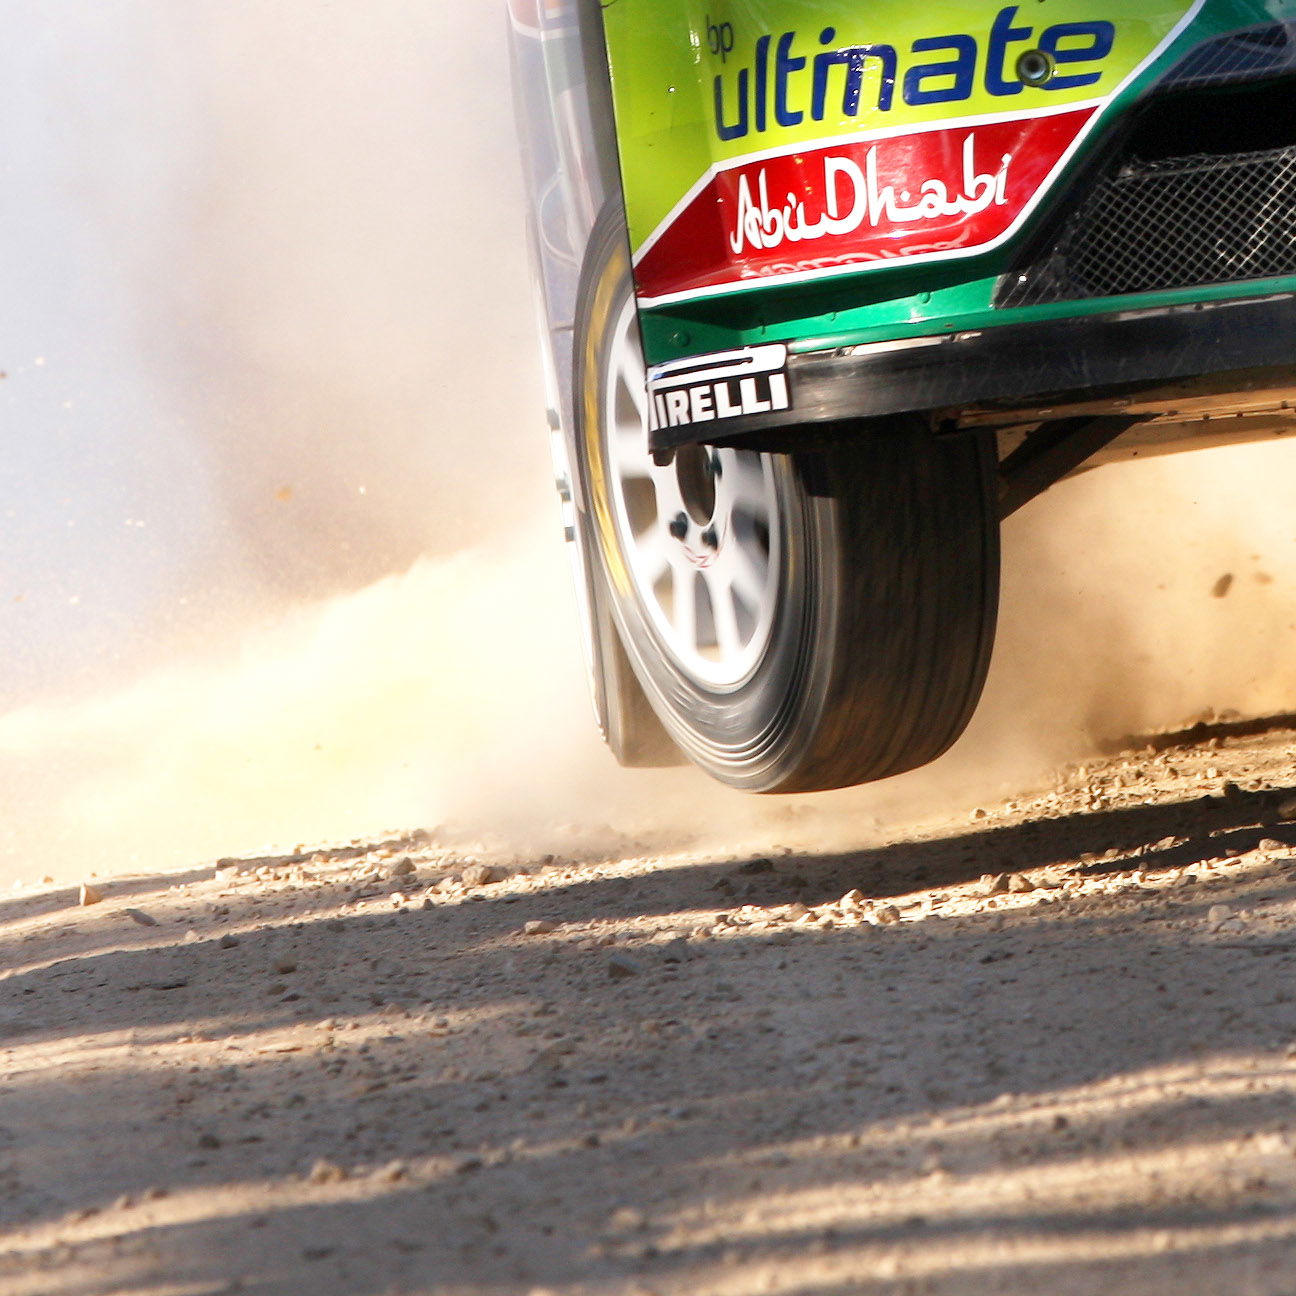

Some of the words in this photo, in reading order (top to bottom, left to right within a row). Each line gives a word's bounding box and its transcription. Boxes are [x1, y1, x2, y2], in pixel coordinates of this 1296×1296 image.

[706, 15, 735, 60] bp
[714, 6, 1116, 142] ultimate
[820, 132, 1013, 238] Dhabi
